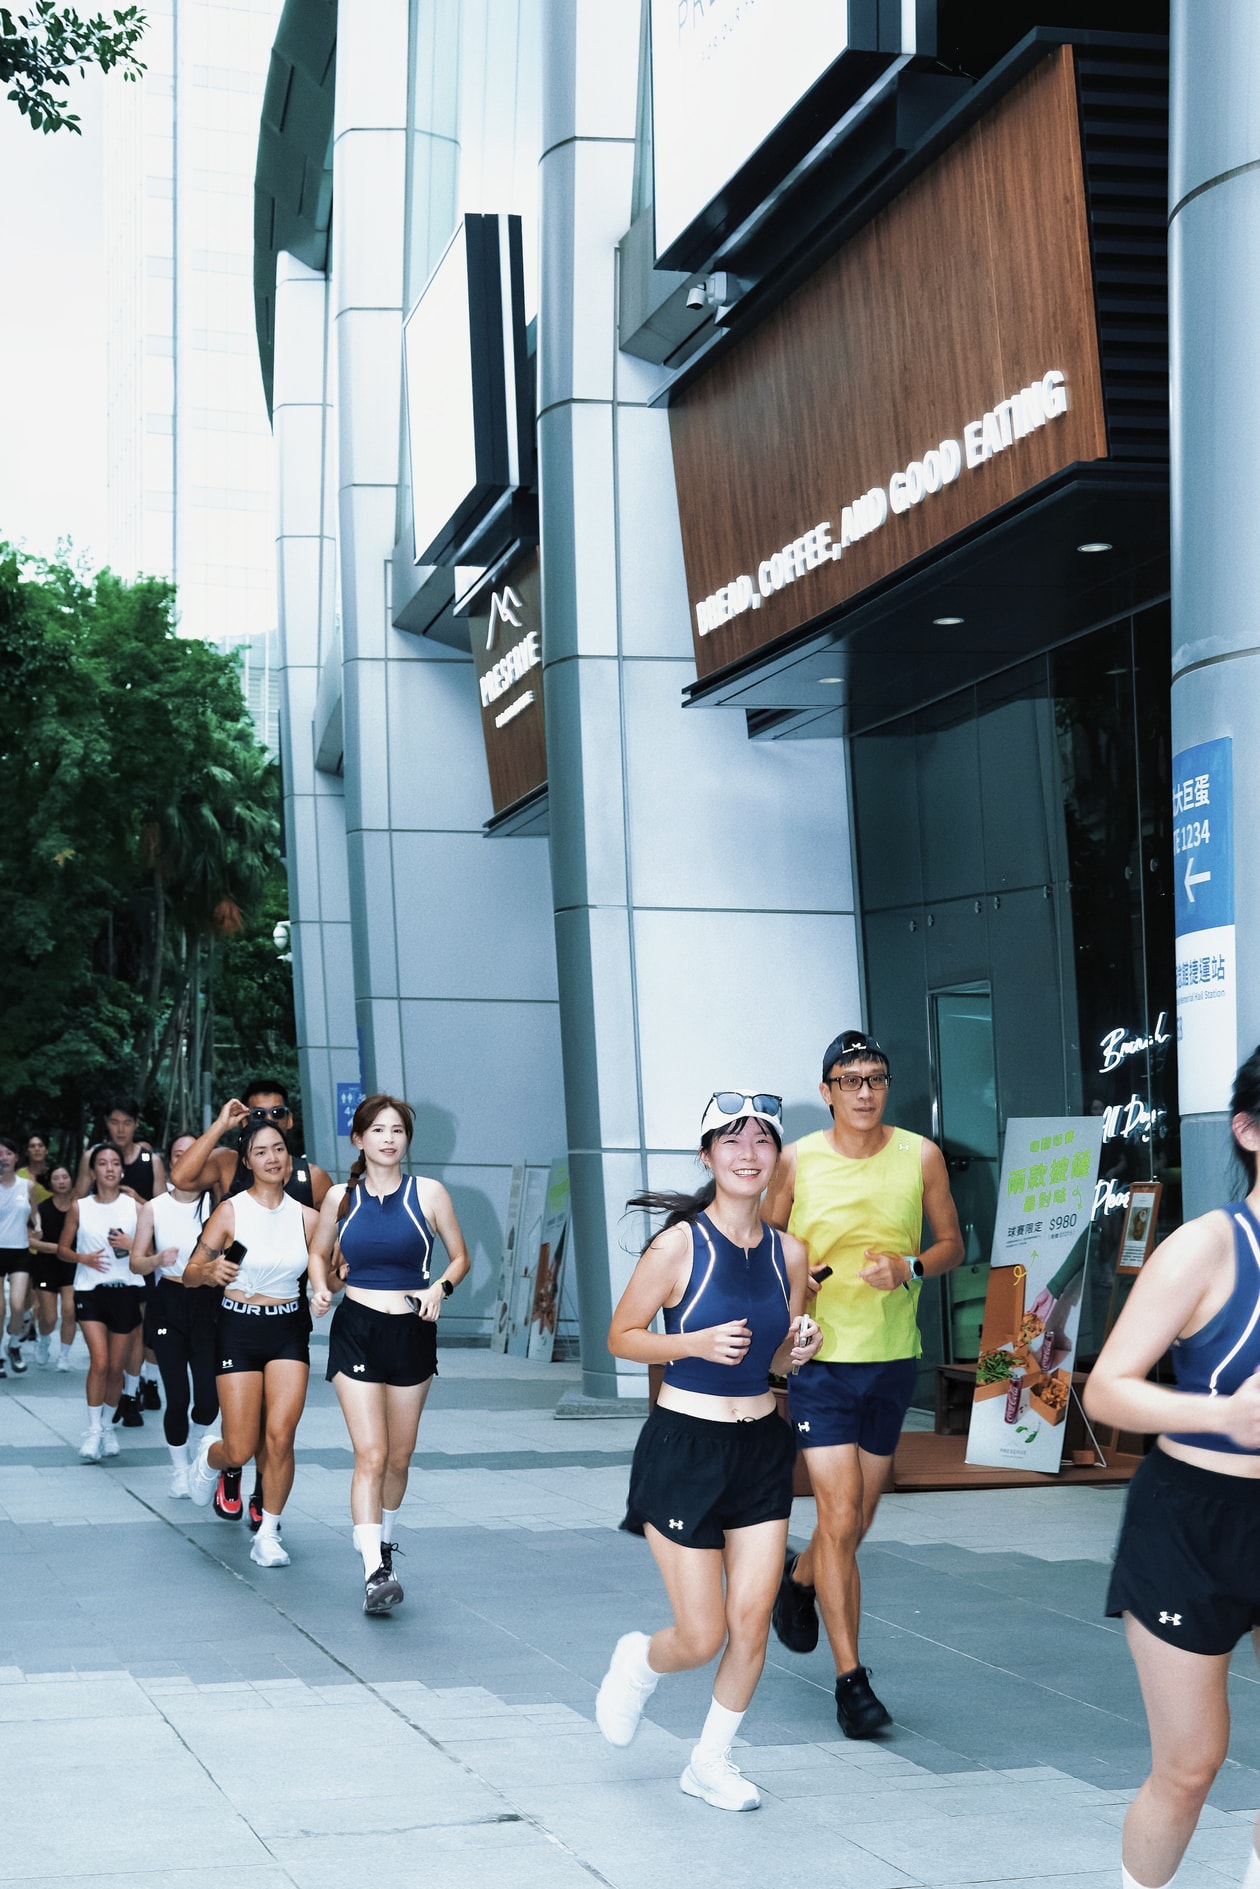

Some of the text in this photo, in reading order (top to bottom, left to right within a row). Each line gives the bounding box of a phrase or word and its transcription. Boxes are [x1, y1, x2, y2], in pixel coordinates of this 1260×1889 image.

[696, 370, 1067, 636] BREAD, COFFEE, AND GOOD EATING
[1181, 819, 1210, 851] 1234
[1049, 1213, 1077, 1231] $980
